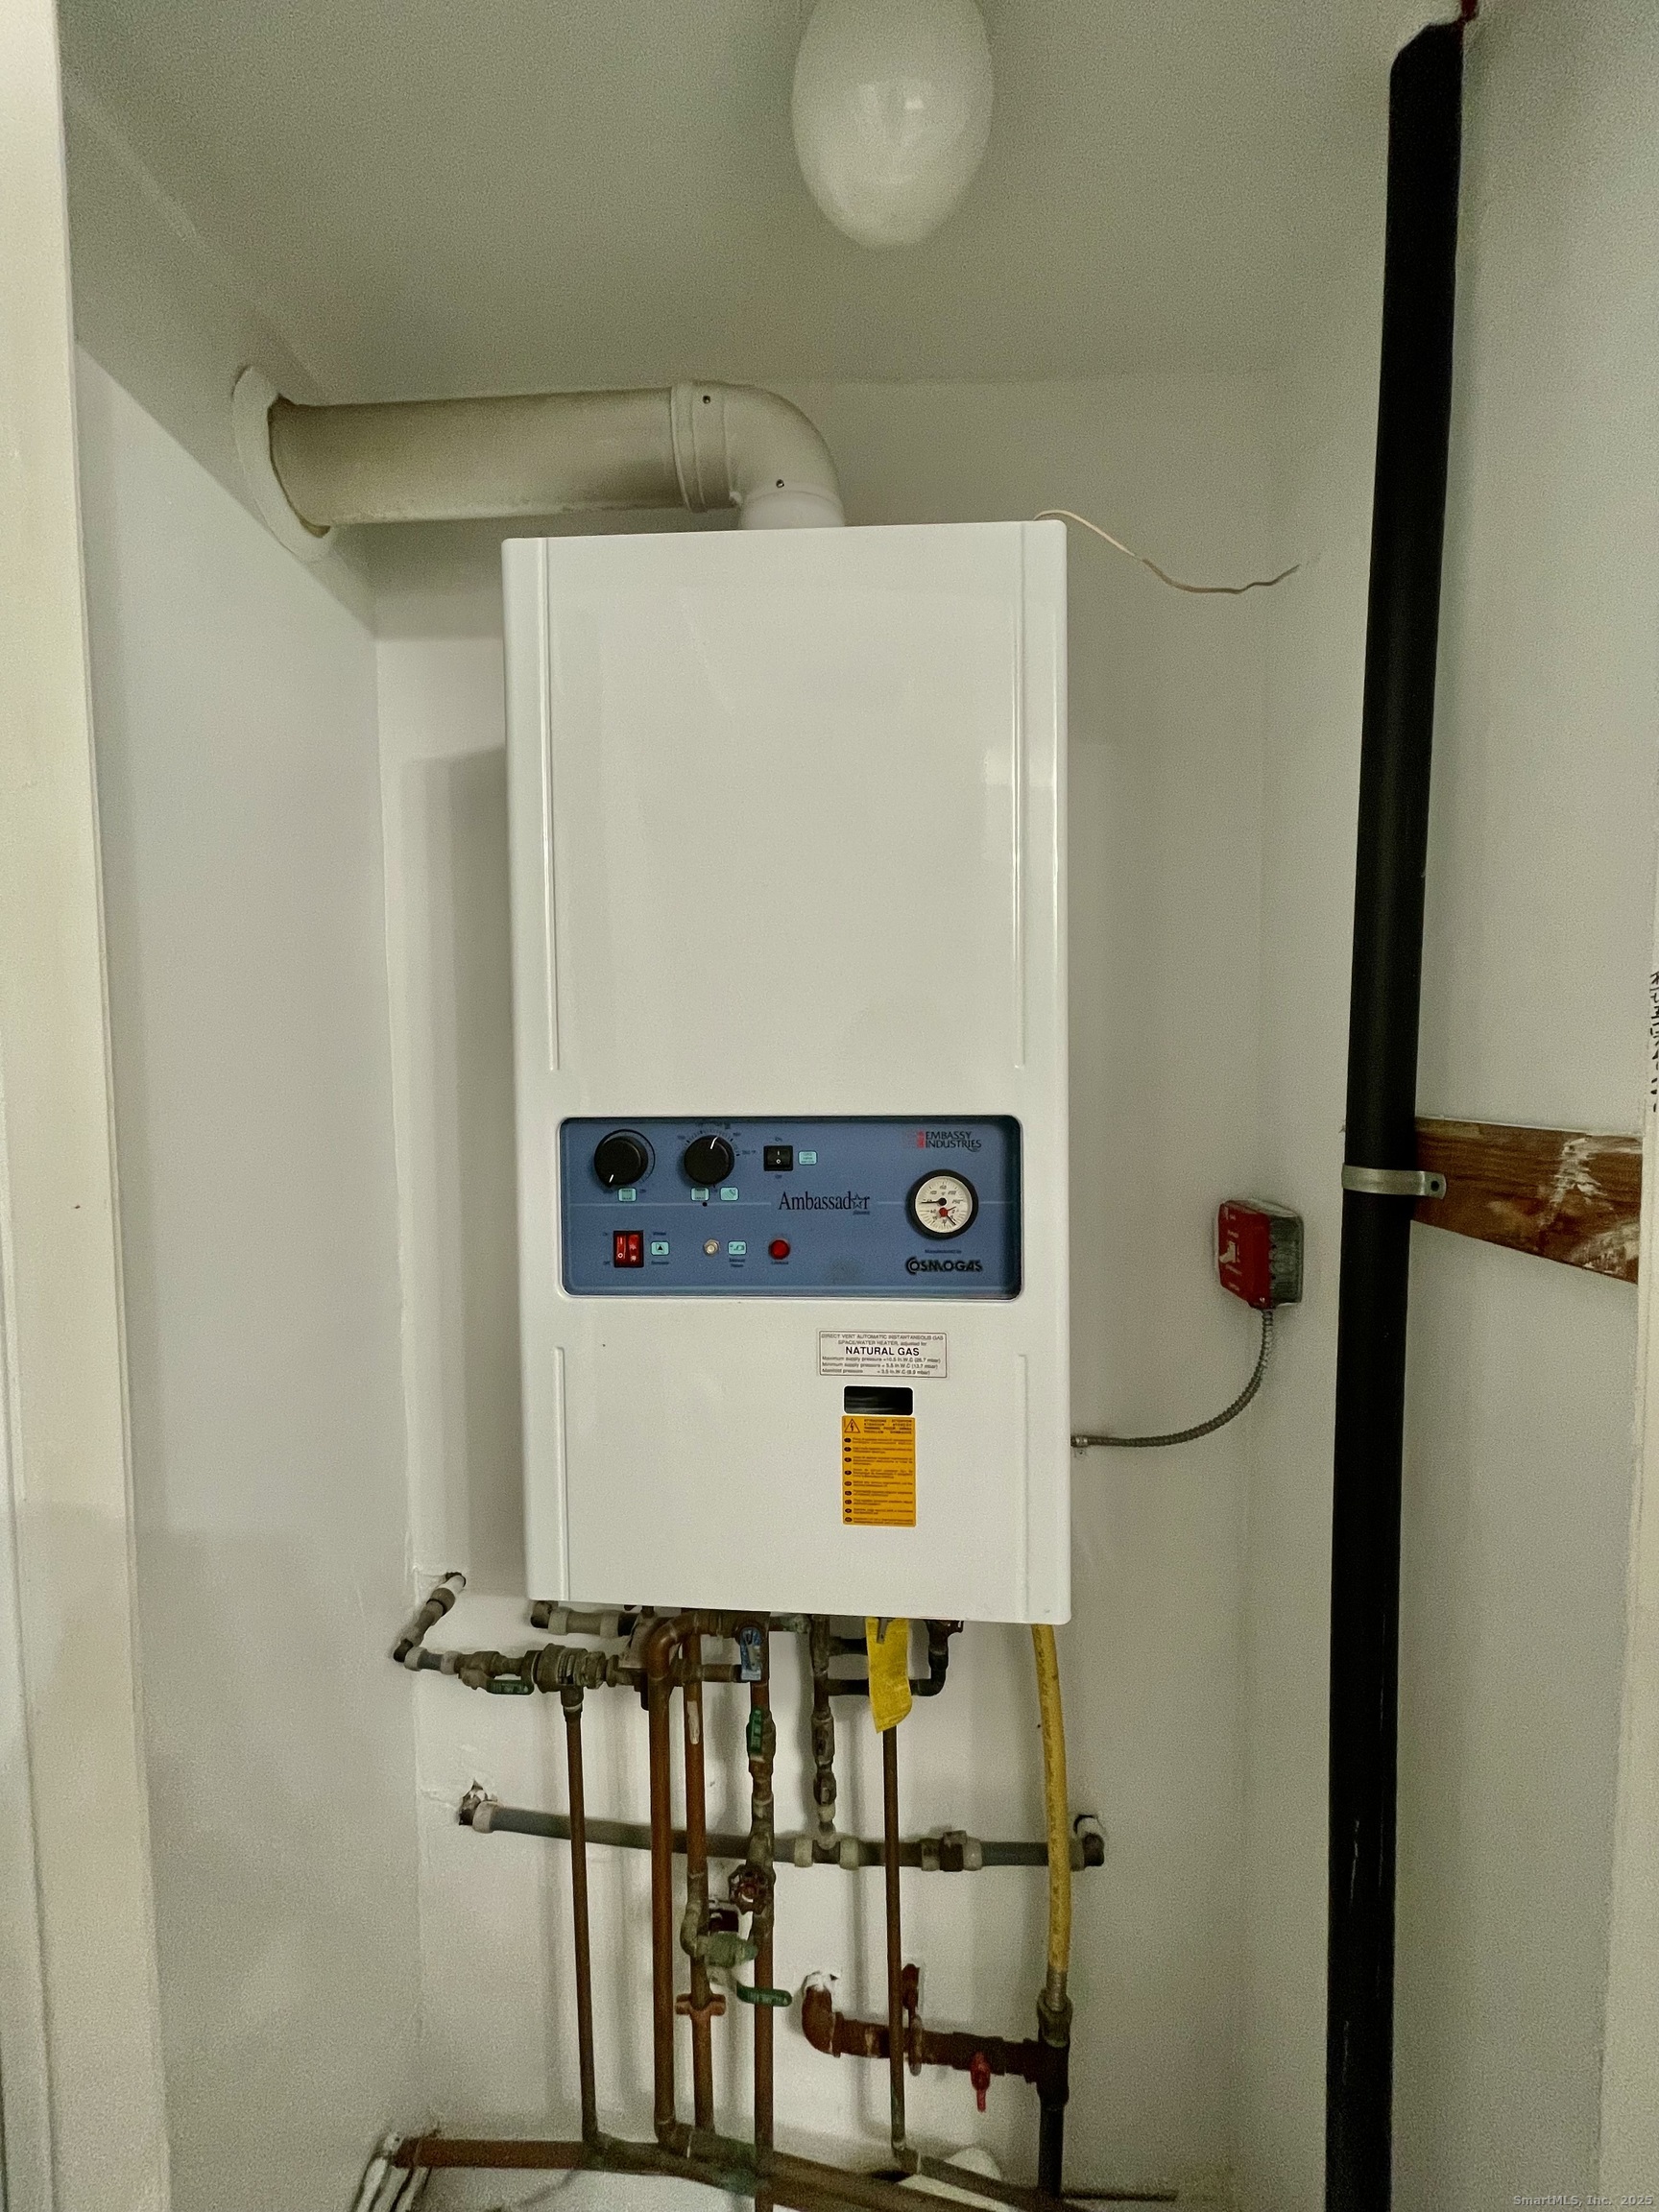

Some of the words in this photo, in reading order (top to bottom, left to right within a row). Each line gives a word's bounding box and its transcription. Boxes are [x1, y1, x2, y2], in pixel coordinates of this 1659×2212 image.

[926, 1131, 972, 1140] EMBASSY
[926, 1140, 982, 1152] INDUSTRIES
[905, 1256, 983, 1276] COSMOGAS
[845, 1346, 895, 1356] NATURAL
[897, 1347, 920, 1357] GAS
